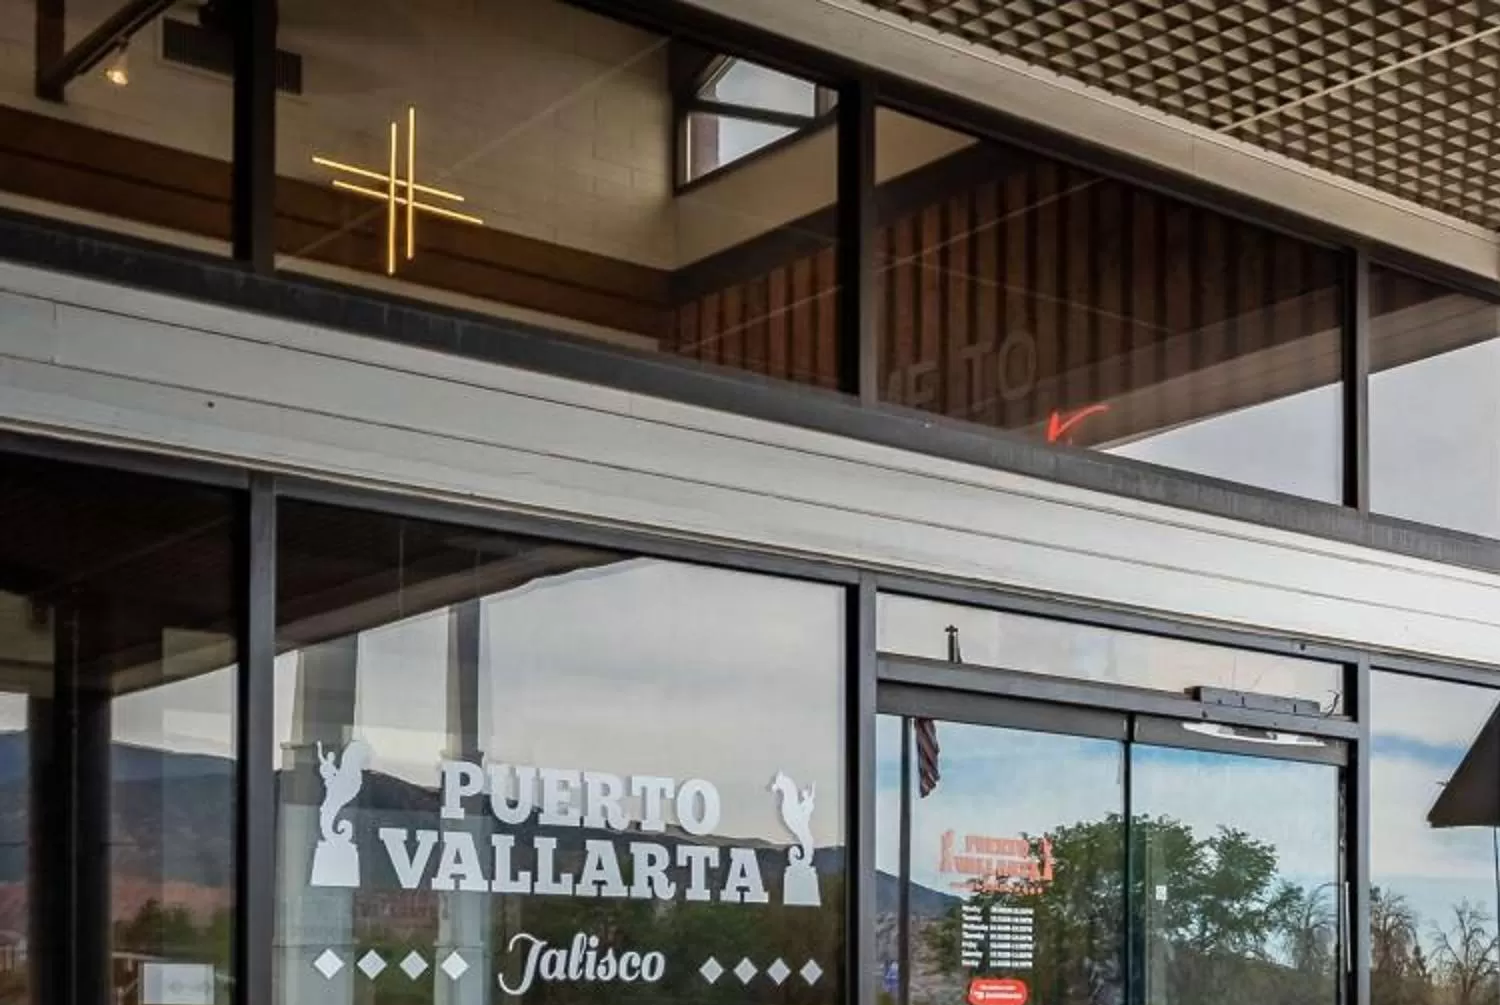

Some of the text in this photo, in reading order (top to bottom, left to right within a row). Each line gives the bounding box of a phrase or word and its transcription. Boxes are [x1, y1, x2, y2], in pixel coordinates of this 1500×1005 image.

[440, 761, 721, 836] PUERTO
[379, 827, 769, 904] VALLARTA
[498, 932, 666, 995] Jalisco
